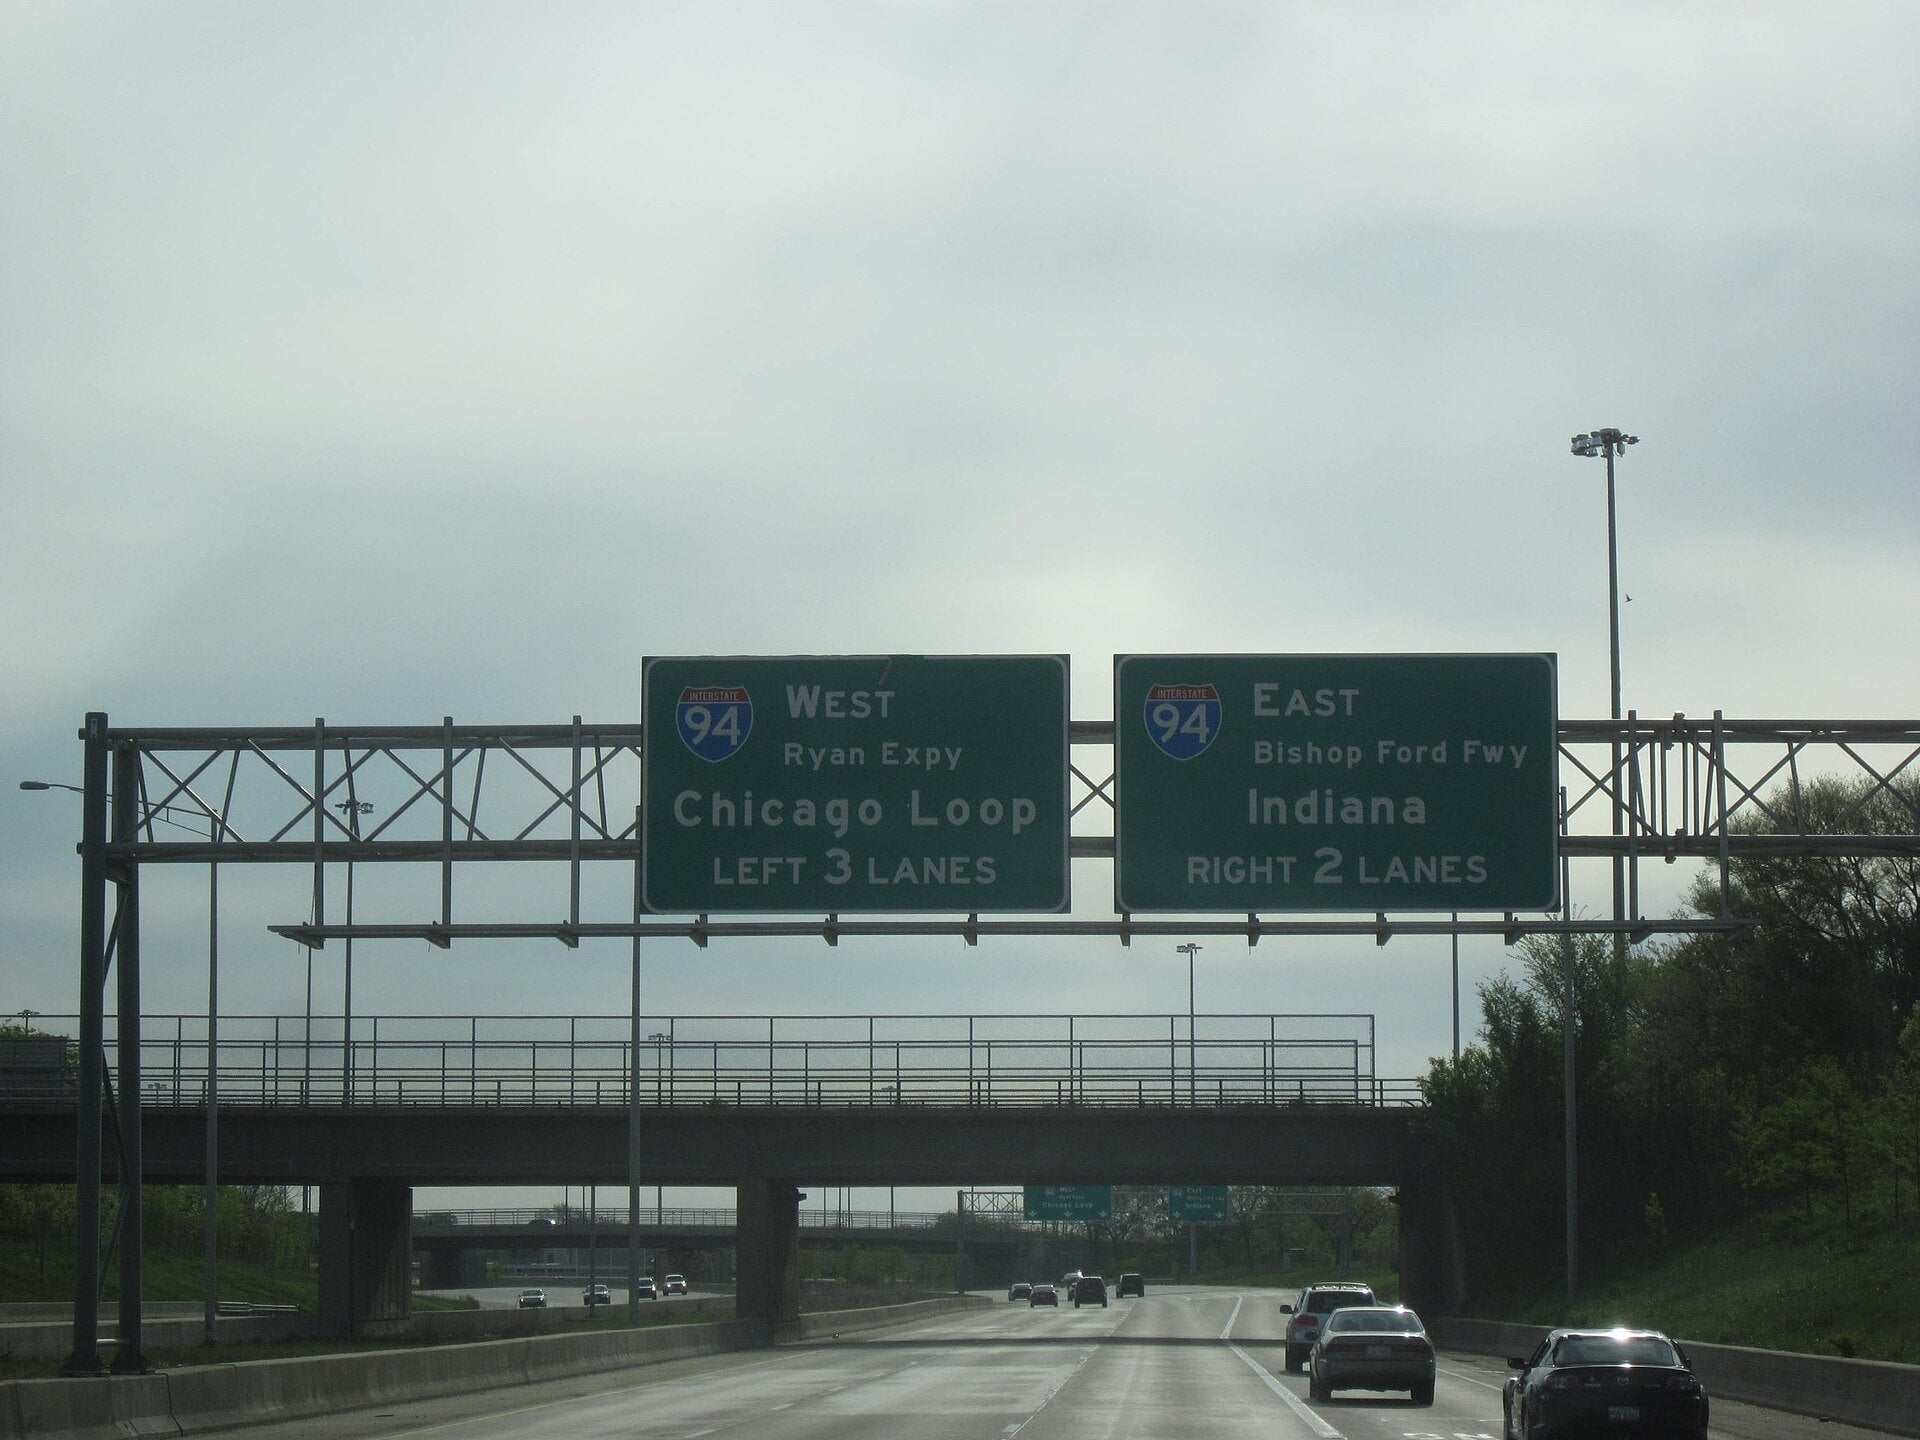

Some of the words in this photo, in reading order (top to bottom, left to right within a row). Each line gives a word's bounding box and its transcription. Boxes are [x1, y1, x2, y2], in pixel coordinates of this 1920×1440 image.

[688, 691, 740, 702] INTERSTATE
[785, 684, 896, 719] WEST
[1156, 688, 1208, 700] INTERSTATE
[1253, 682, 1360, 717] EAST
[684, 705, 742, 747] 94
[1152, 703, 1211, 744] 94
[784, 743, 865, 771] Ryan
[882, 742, 963, 771] Expy
[1254, 741, 1362, 769] Bishop
[1378, 741, 1447, 764] Ford
[1463, 741, 1528, 769] Fwy
[673, 790, 884, 837] Chicago
[911, 790, 1037, 835] Loop
[1249, 788, 1427, 825] Indiana
[713, 857, 807, 885] LEFT
[823, 848, 853, 886] 3
[868, 856, 997, 885] LANES
[1187, 856, 1297, 884] RIGHT
[1313, 847, 1344, 884] 2
[1359, 855, 1488, 884] LANES
